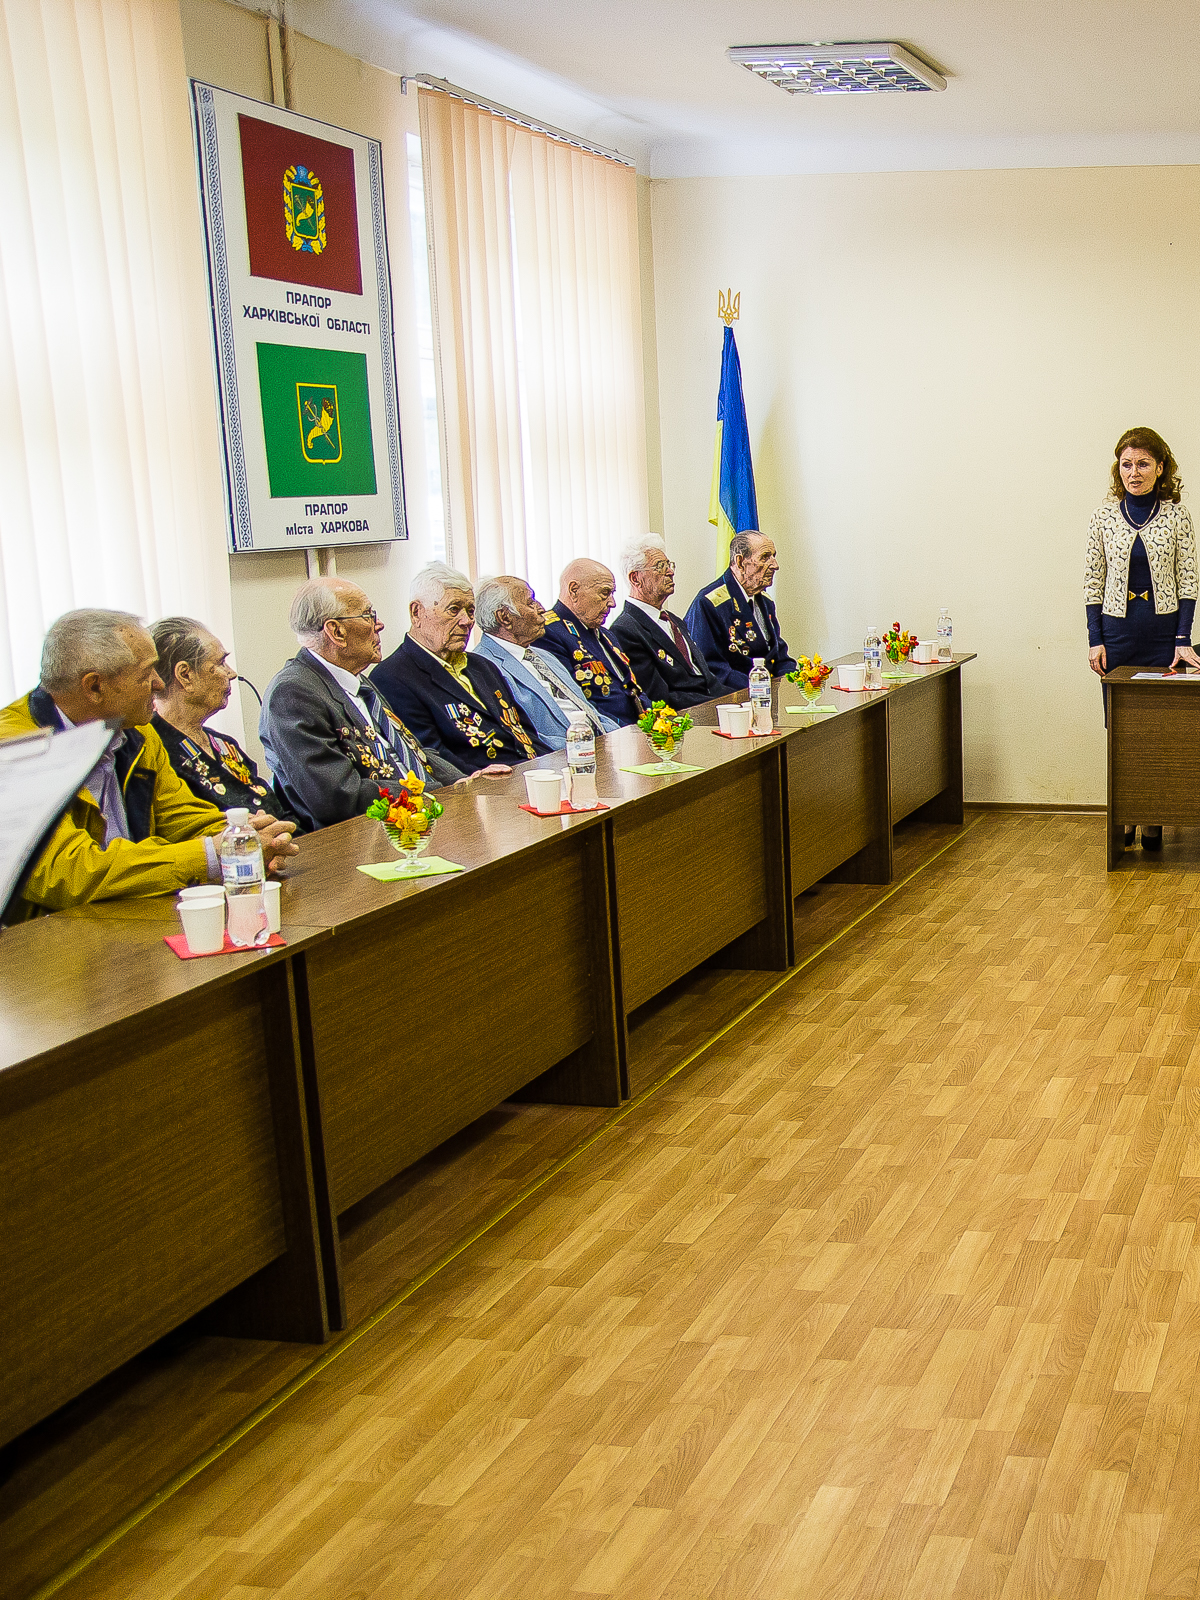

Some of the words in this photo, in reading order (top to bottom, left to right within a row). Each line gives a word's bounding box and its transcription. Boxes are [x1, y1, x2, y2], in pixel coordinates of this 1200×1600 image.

[286, 291, 332, 309] ПРАПОР
[242, 304, 320, 328] ХАРКІВСЬКОЇ
[326, 317, 370, 335] ОБЛАСТІ
[304, 502, 349, 516] ПРАПОР
[320, 519, 370, 534] ХАРКОВА
